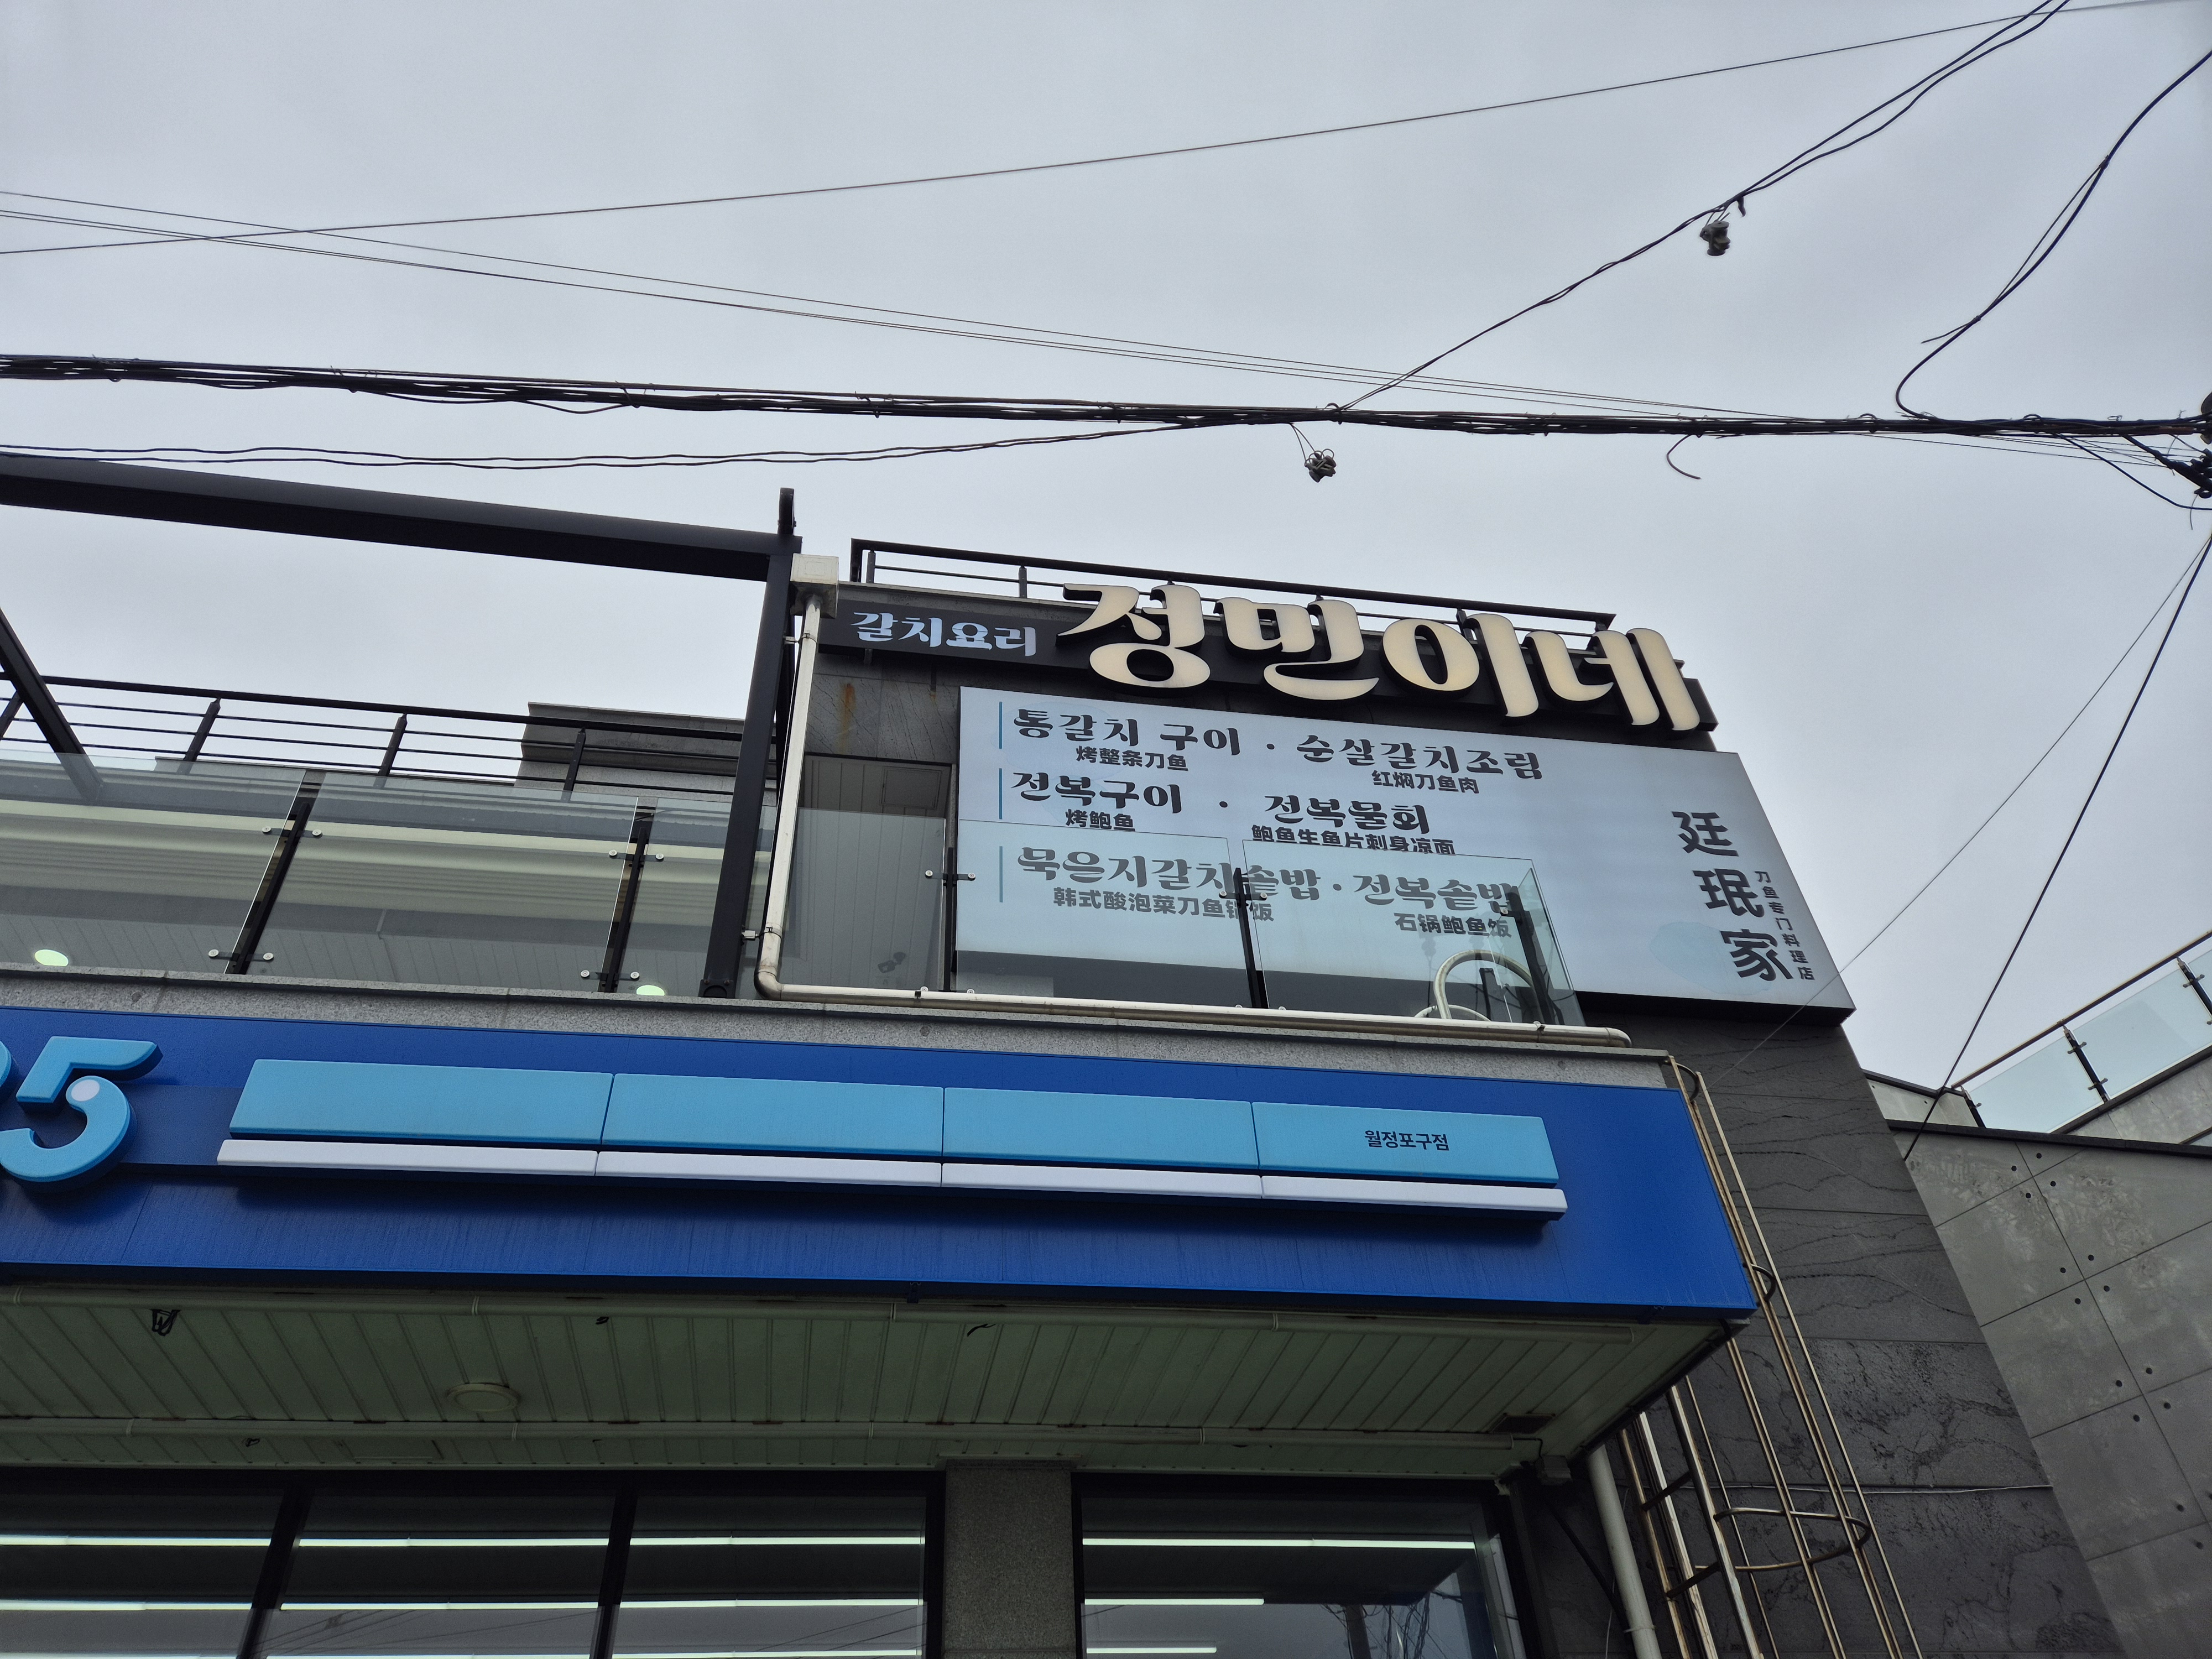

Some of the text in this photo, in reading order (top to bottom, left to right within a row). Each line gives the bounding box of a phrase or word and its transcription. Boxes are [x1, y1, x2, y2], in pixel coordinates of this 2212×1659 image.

[851, 611, 1037, 656] 갈치요리
[1057, 583, 1700, 731] 정민이네
[1013, 709, 1240, 756] 통갈치 구이
[1076, 745, 1189, 771] 烤整条刀鱼
[1296, 734, 1543, 780] 순살갈치조림
[1011, 772, 1182, 813] 전복구이
[1372, 770, 1480, 794] 红焖刀鱼肉
[1065, 808, 1136, 832] 烤鲍鱼
[1264, 795, 1430, 834] 전복물회
[1017, 847, 1321, 900] 묵은지갈치솥밥
[1352, 874, 1515, 914] 전복솥밥
[1671, 811, 1793, 982] 廷珉家
[1394, 912, 1512, 938] 石锅鲍鱼饭
[1755, 870, 1815, 980] 刀鱼专门料理店
[0, 1036, 159, 1182] 5
[1364, 1130, 1449, 1151] 월정포구점
